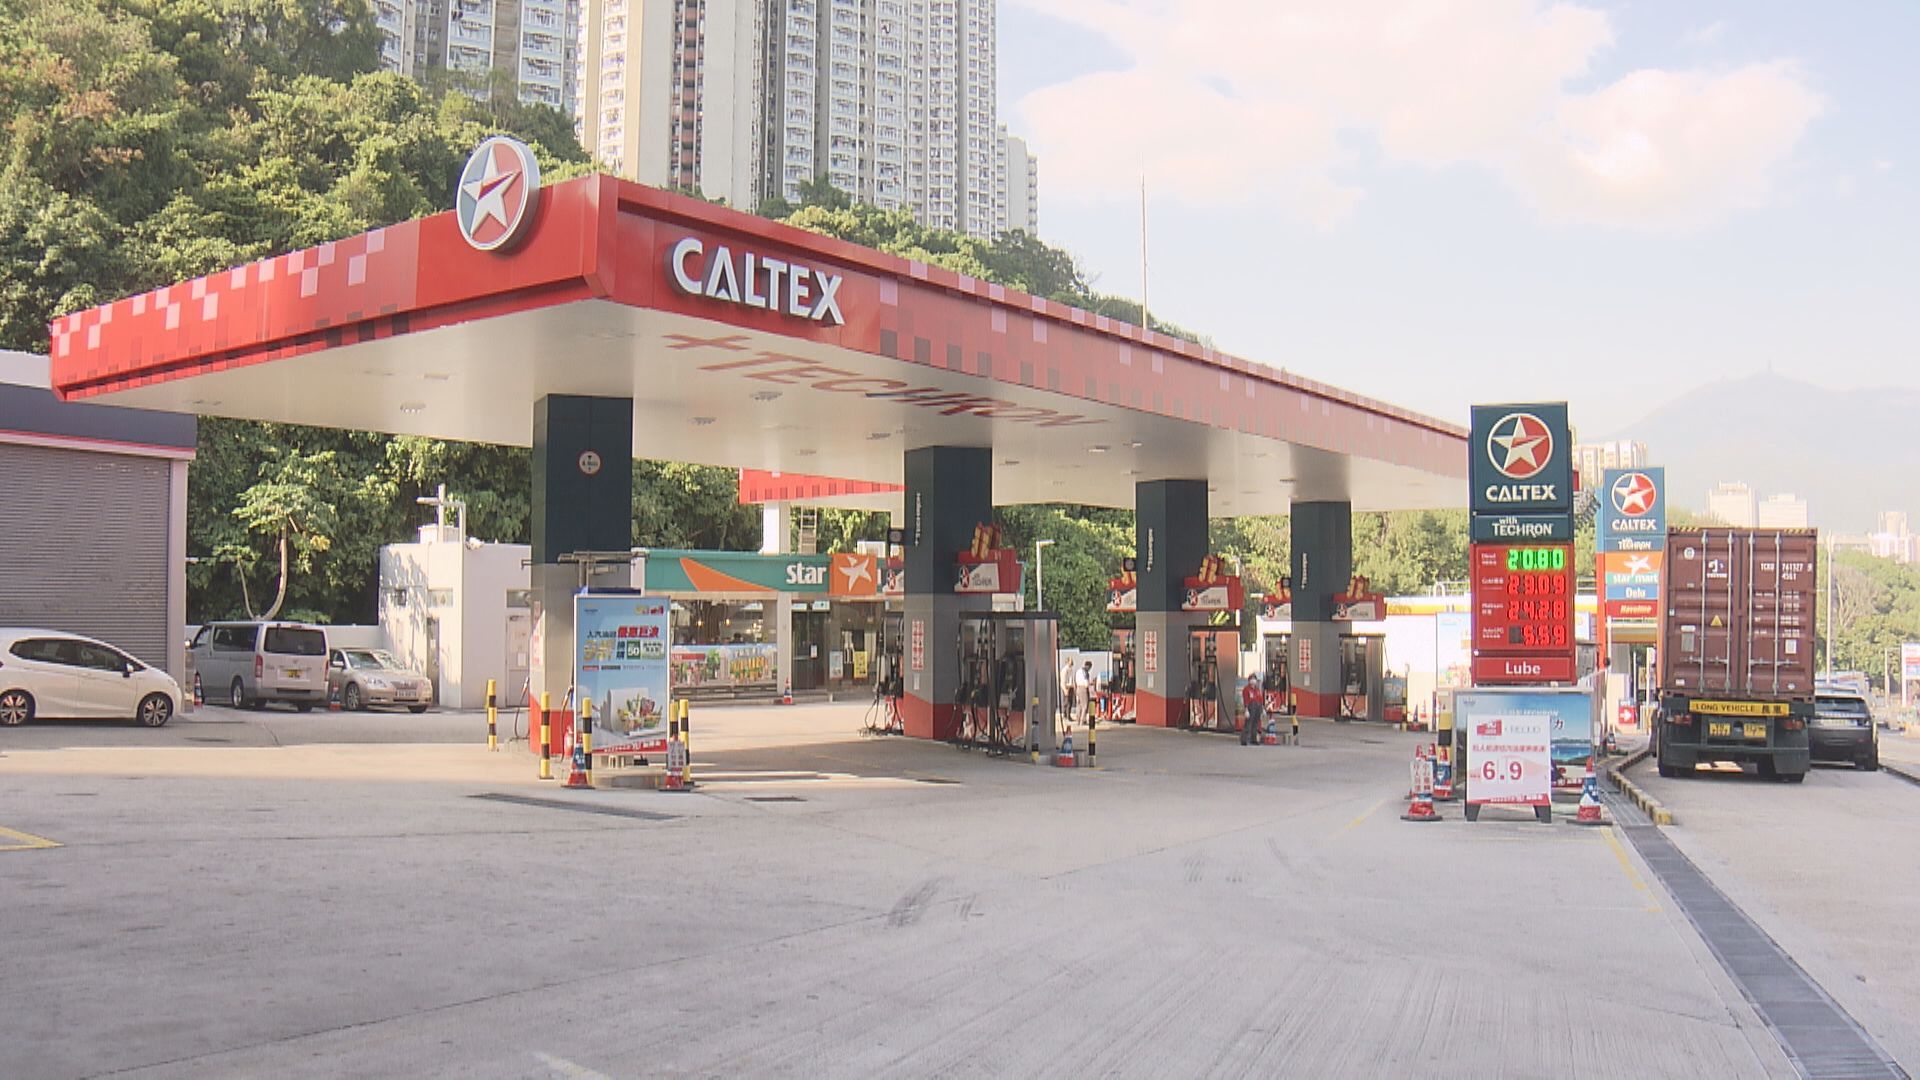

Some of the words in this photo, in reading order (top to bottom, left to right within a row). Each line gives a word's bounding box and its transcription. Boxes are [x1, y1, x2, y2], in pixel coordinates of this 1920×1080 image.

[671, 237, 845, 325] CALTEX
[1486, 484, 1557, 502] CALTEX
[1497, 515, 1518, 525] with
[1612, 519, 1657, 532] CALTEX
[1491, 523, 1553, 538] TECHRON
[786, 562, 827, 584] star
[1505, 660, 1541, 675] Lube
[1695, 703, 1719, 712] LONG
[1721, 704, 1753, 713] VEHICLE
[1482, 760, 1523, 780] 6.9
